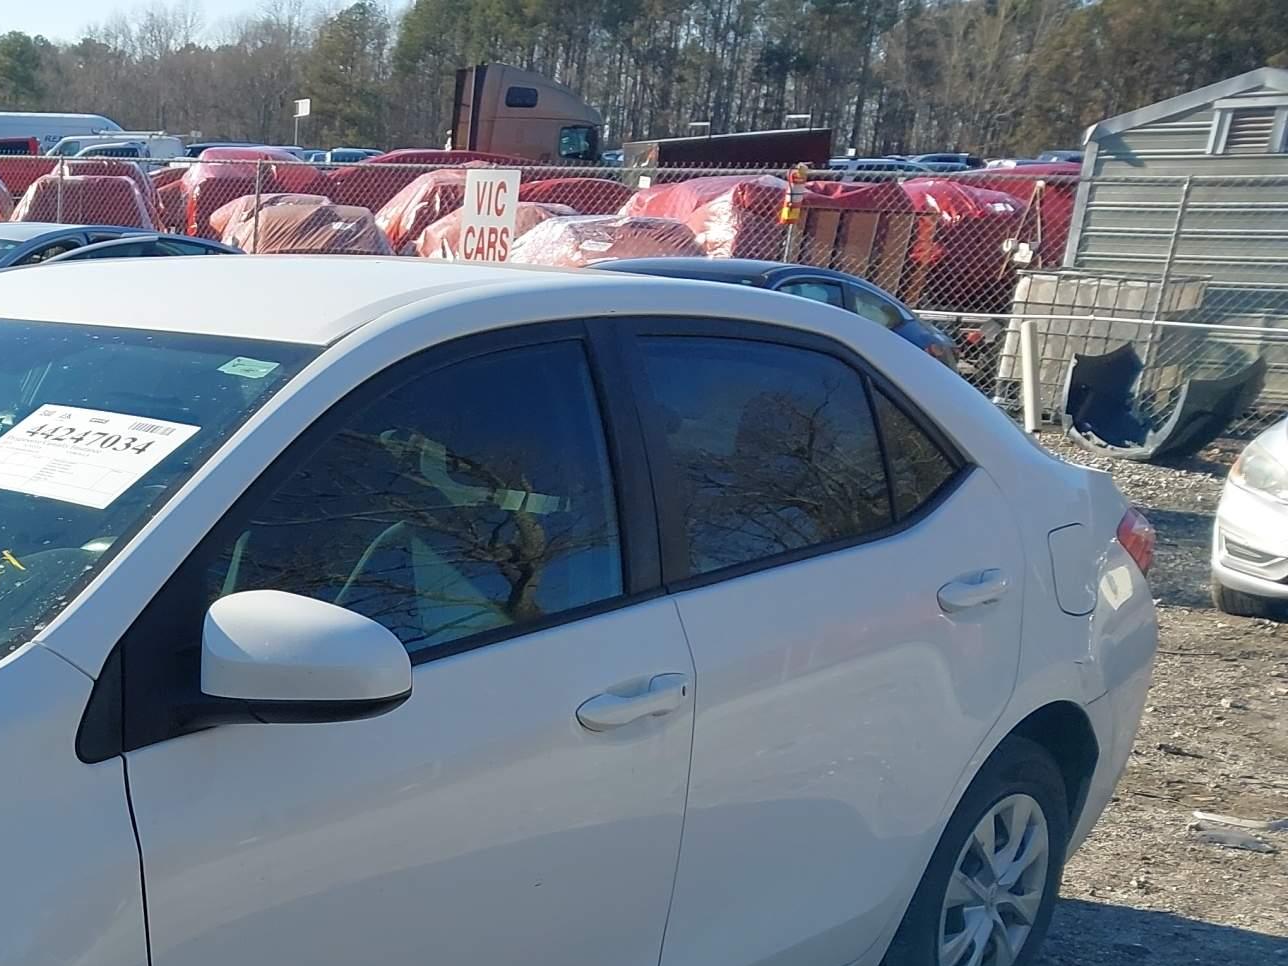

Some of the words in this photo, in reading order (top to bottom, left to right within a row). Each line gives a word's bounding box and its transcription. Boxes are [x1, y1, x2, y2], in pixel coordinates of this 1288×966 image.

[476, 180, 509, 217] VIC
[463, 225, 510, 263] CARS
[24, 423, 157, 456] 44247034
